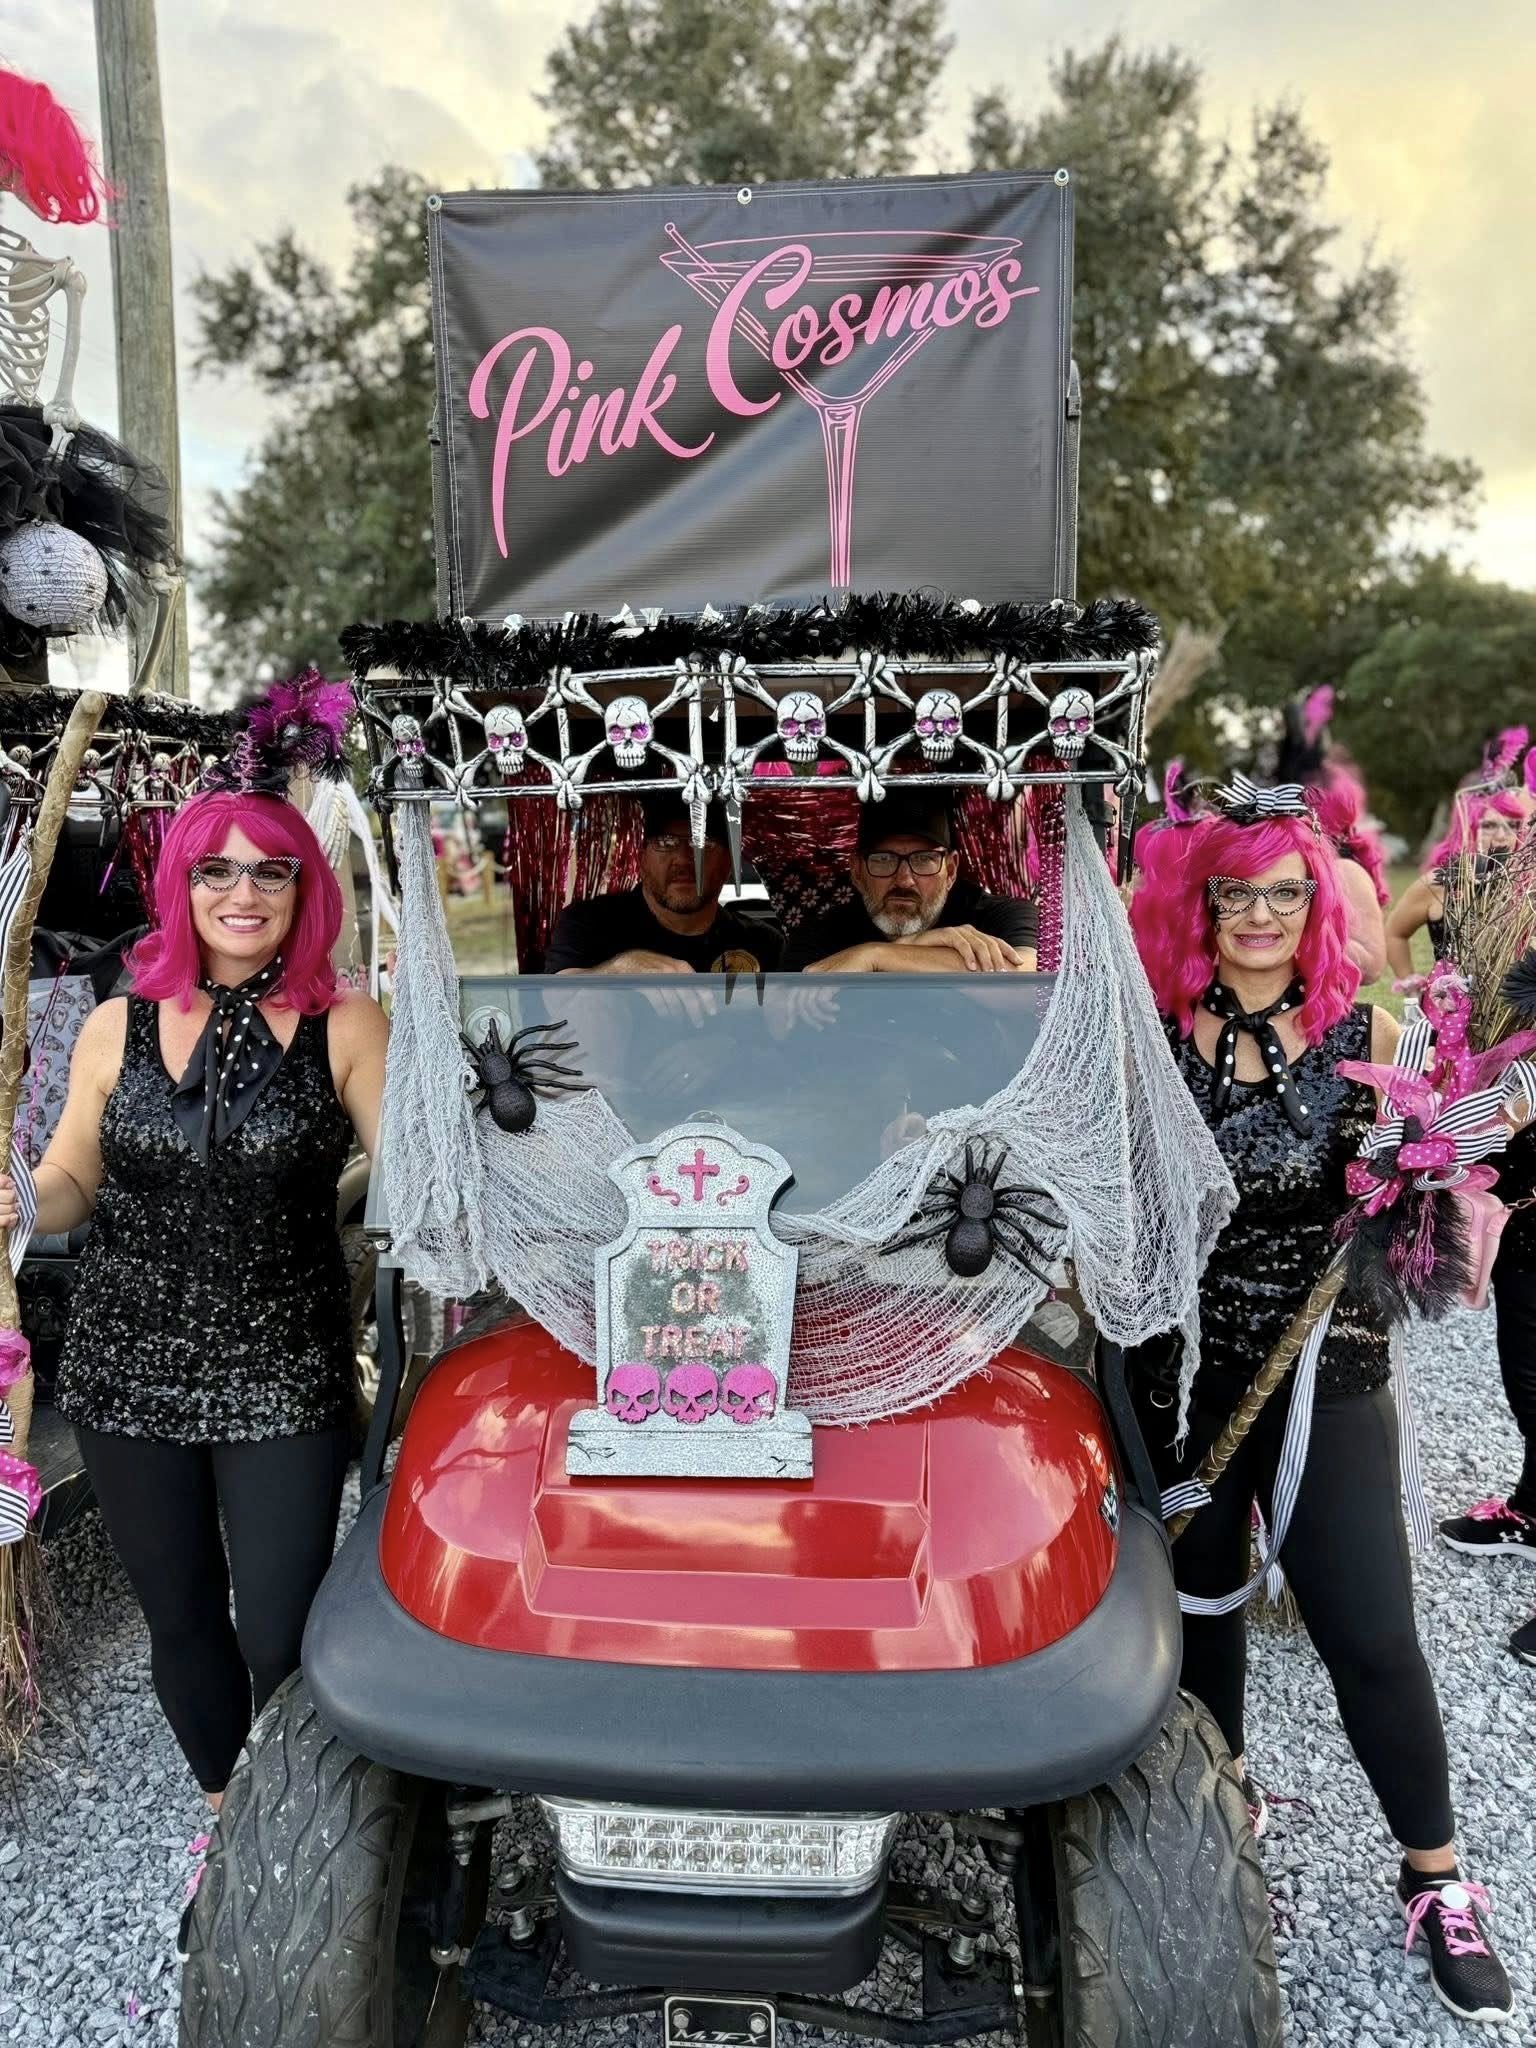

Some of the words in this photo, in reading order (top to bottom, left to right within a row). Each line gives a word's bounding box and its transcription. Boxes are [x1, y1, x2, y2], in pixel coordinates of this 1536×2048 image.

[468, 325, 715, 559] Pink
[706, 243, 1040, 416] Cosmos
[647, 1239, 749, 1273] TRICK
[670, 1281, 722, 1314] OR
[639, 1326, 748, 1358] TREAT
